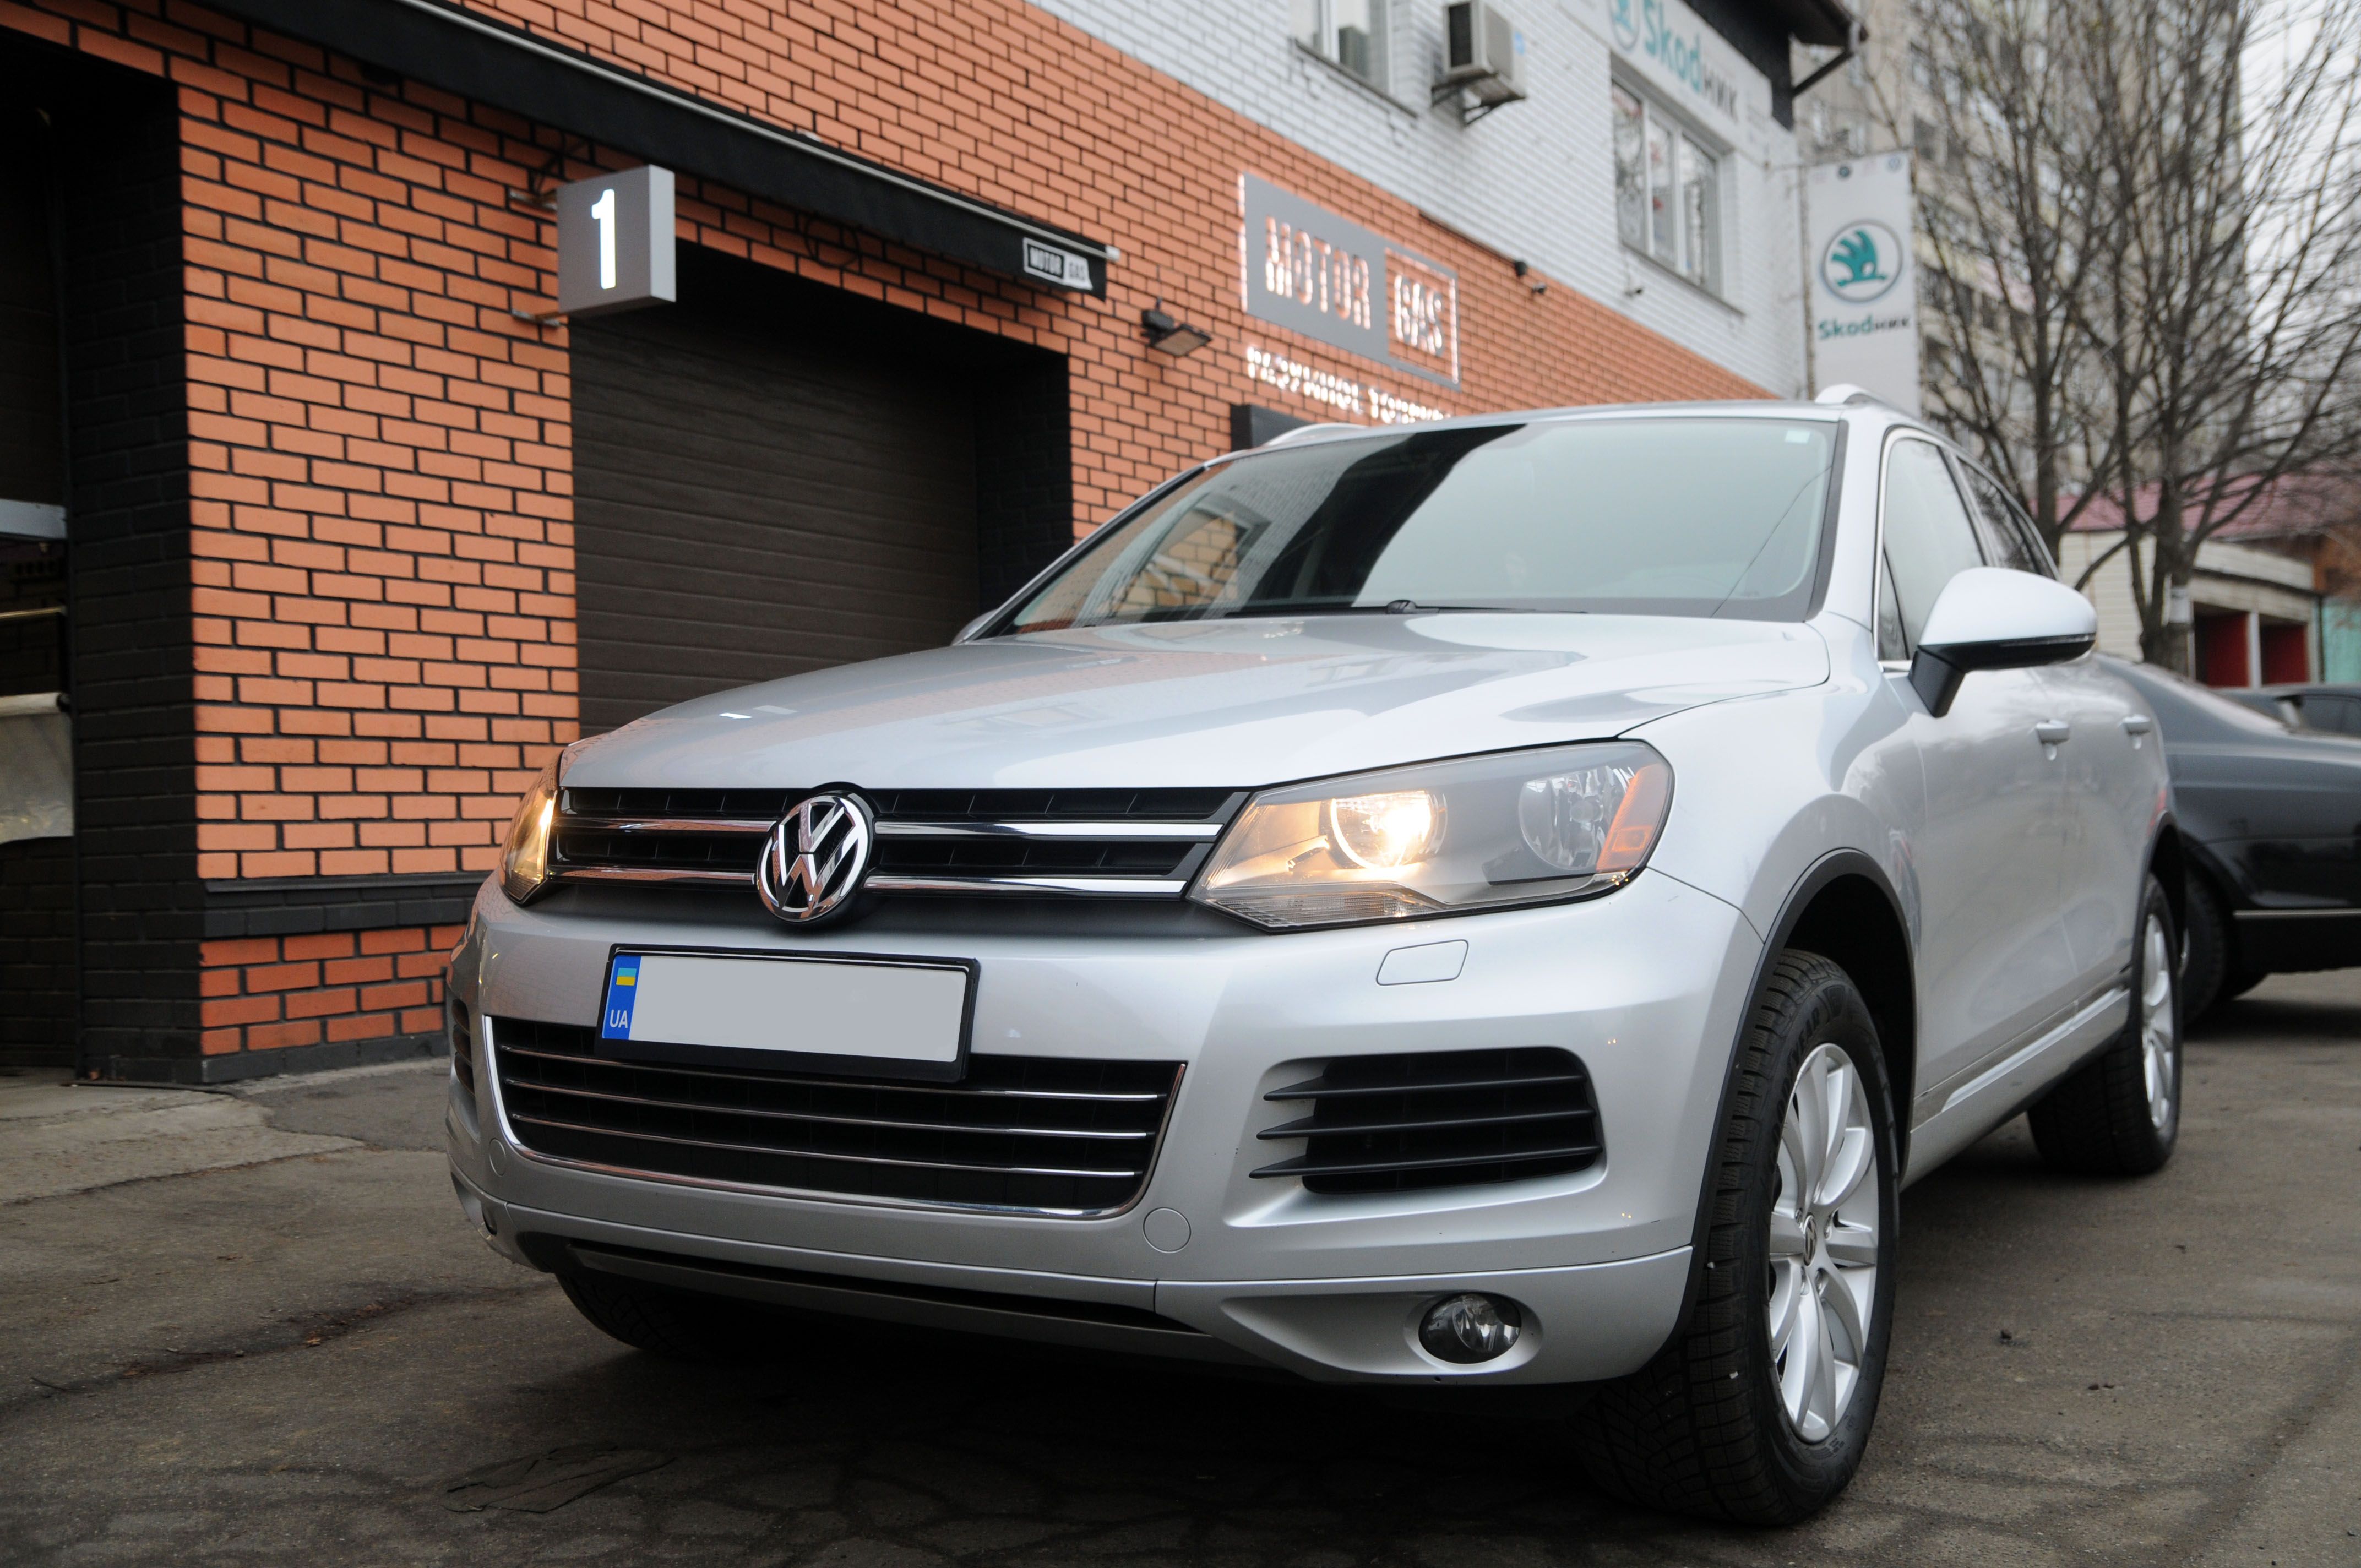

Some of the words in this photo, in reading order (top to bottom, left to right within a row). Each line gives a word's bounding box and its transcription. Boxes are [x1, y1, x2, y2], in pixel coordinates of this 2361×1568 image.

[591, 188, 616, 290] 1
[1265, 216, 1371, 330] MOTOR
[1395, 274, 1444, 356] GAS
[610, 1009, 628, 1028] UA
